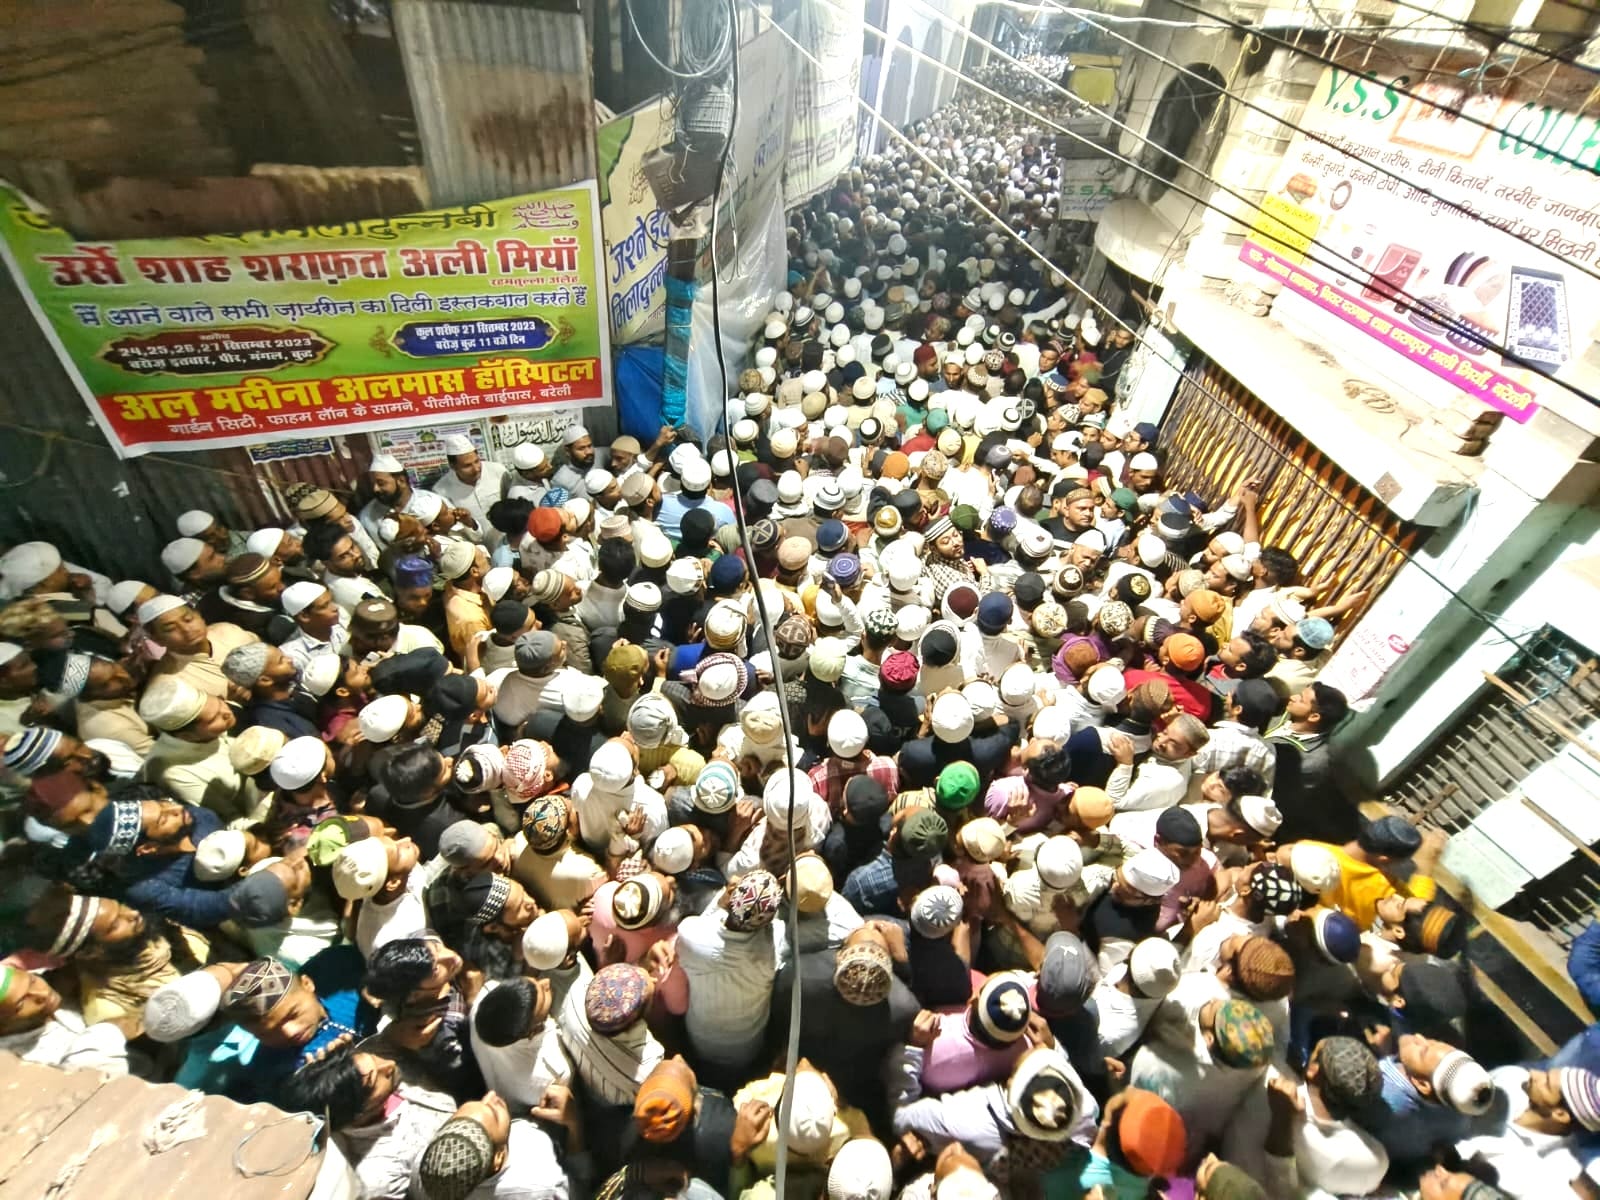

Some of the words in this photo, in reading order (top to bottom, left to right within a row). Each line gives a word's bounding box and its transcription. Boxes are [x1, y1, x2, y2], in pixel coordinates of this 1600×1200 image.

[1418, 158, 1446, 179] दीनी
[132, 255, 233, 284] शाह
[400, 239, 488, 279] अली
[497, 237, 580, 274] मियाँ
[609, 215, 648, 285] जश्ने
[72, 303, 101, 327] में
[108, 302, 162, 326] आने
[168, 302, 214, 323] वाले
[220, 299, 269, 322] सभी
[360, 299, 386, 316] का
[391, 293, 433, 315] दिली
[532, 287, 570, 306] करते
[571, 285, 588, 306] हैं
[274, 337, 312, 348] 2023
[461, 325, 475, 337] 27
[510, 321, 536, 333] 2023
[479, 337, 491, 348] 11
[509, 334, 526, 347] दिन
[112, 390, 200, 421] अल
[203, 378, 323, 414] मदीना
[335, 367, 464, 402] अलमास
[472, 358, 596, 390] हॉस्पिटल
[168, 417, 214, 435] गार्डन
[217, 415, 264, 431] सिटी,
[267, 412, 313, 426] फाहम
[317, 406, 349, 422] लॉन
[353, 404, 368, 418] के
[372, 400, 419, 416] सामने,
[423, 392, 480, 410] पीलीभीत
[484, 388, 536, 405] बाईपास,
[540, 383, 572, 399] बरेली
